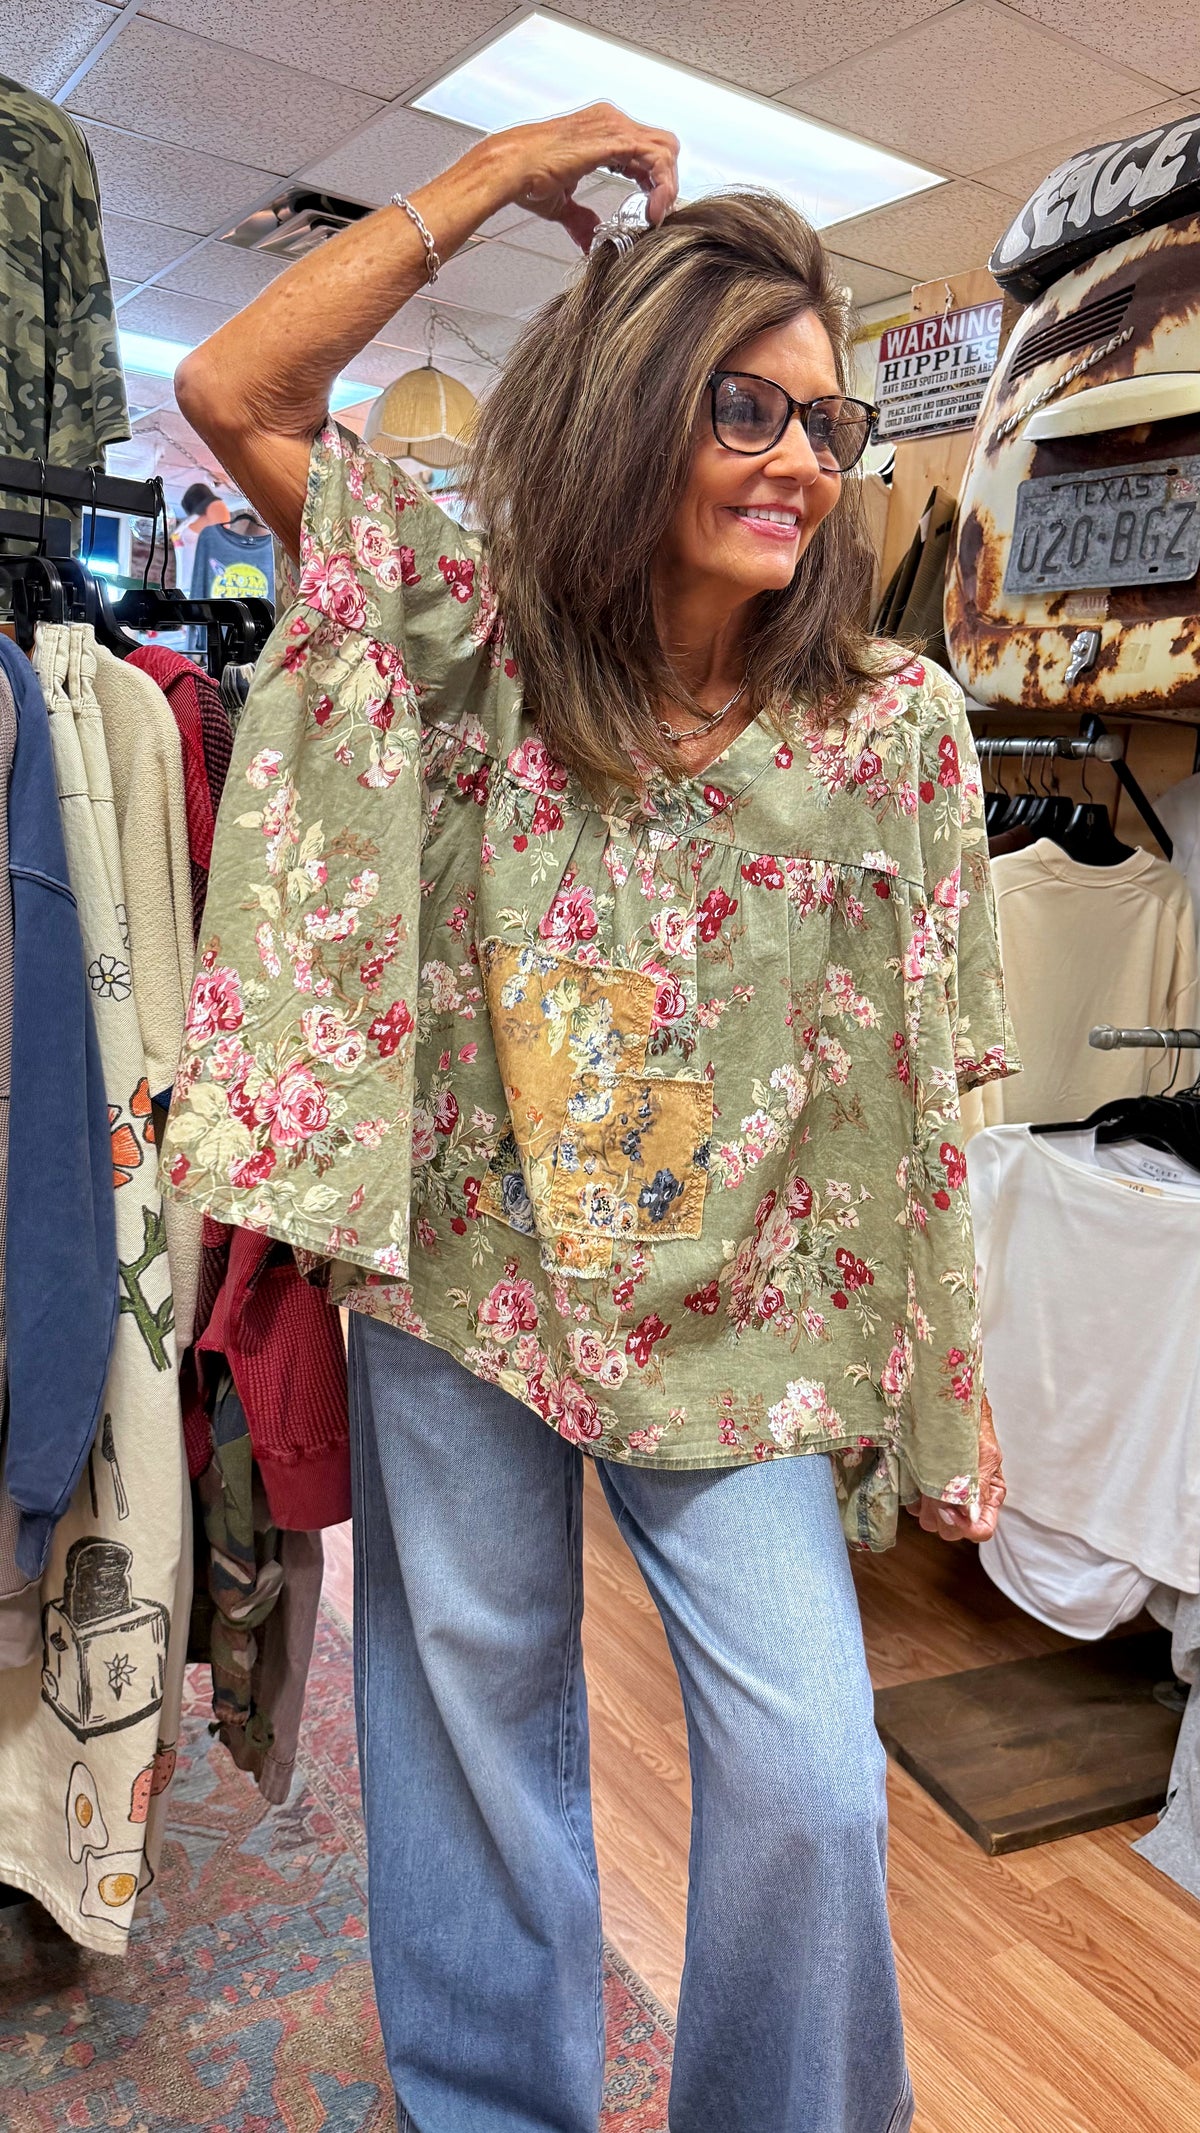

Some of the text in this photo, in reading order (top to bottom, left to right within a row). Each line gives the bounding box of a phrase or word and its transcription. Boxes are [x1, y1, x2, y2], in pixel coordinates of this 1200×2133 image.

[886, 304, 1003, 359] WARNING
[882, 338, 999, 384] HIPPIES
[883, 361, 993, 395] HAVE BEEN SPOTTED IN THIS ARE
[885, 401, 981, 429] COULD BREAK OUT AT ANY MOMEN
[907, 403, 922, 414] LOVE
[923, 400, 934, 411] AND
[1073, 477, 1150, 507] TEXAS
[225, 573, 266, 588] TOM
